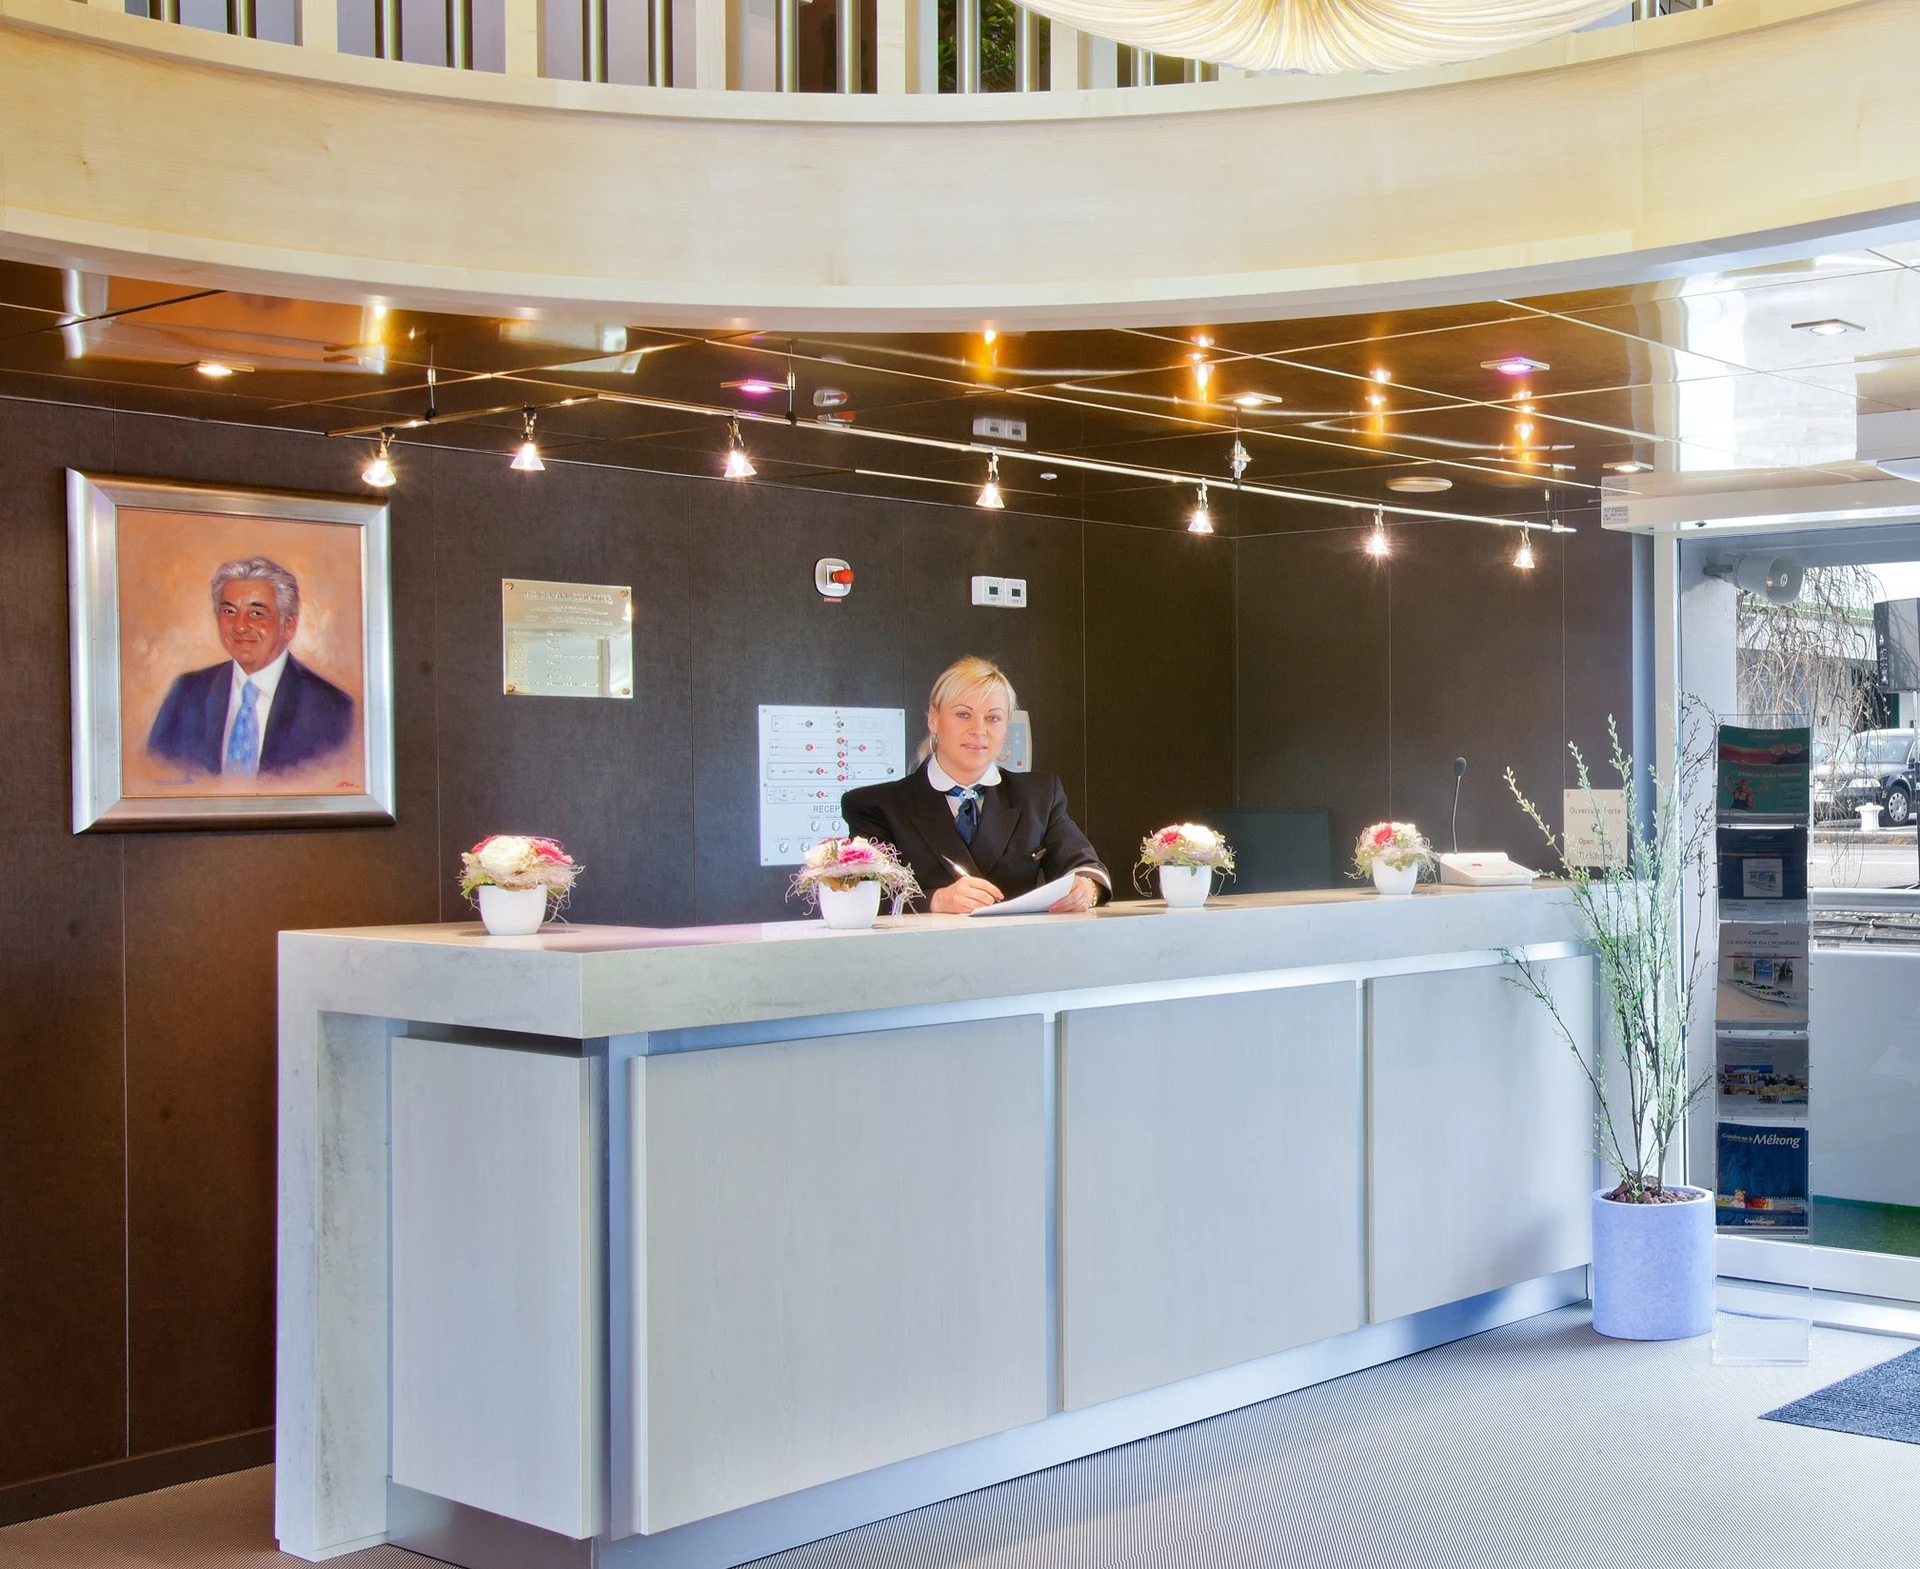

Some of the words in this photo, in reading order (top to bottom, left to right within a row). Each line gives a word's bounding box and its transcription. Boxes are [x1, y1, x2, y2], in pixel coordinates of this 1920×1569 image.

[813, 805, 840, 813] RECEP
[1569, 807, 1600, 815] Ouvertue
[1753, 1133, 1801, 1149] Mékong
